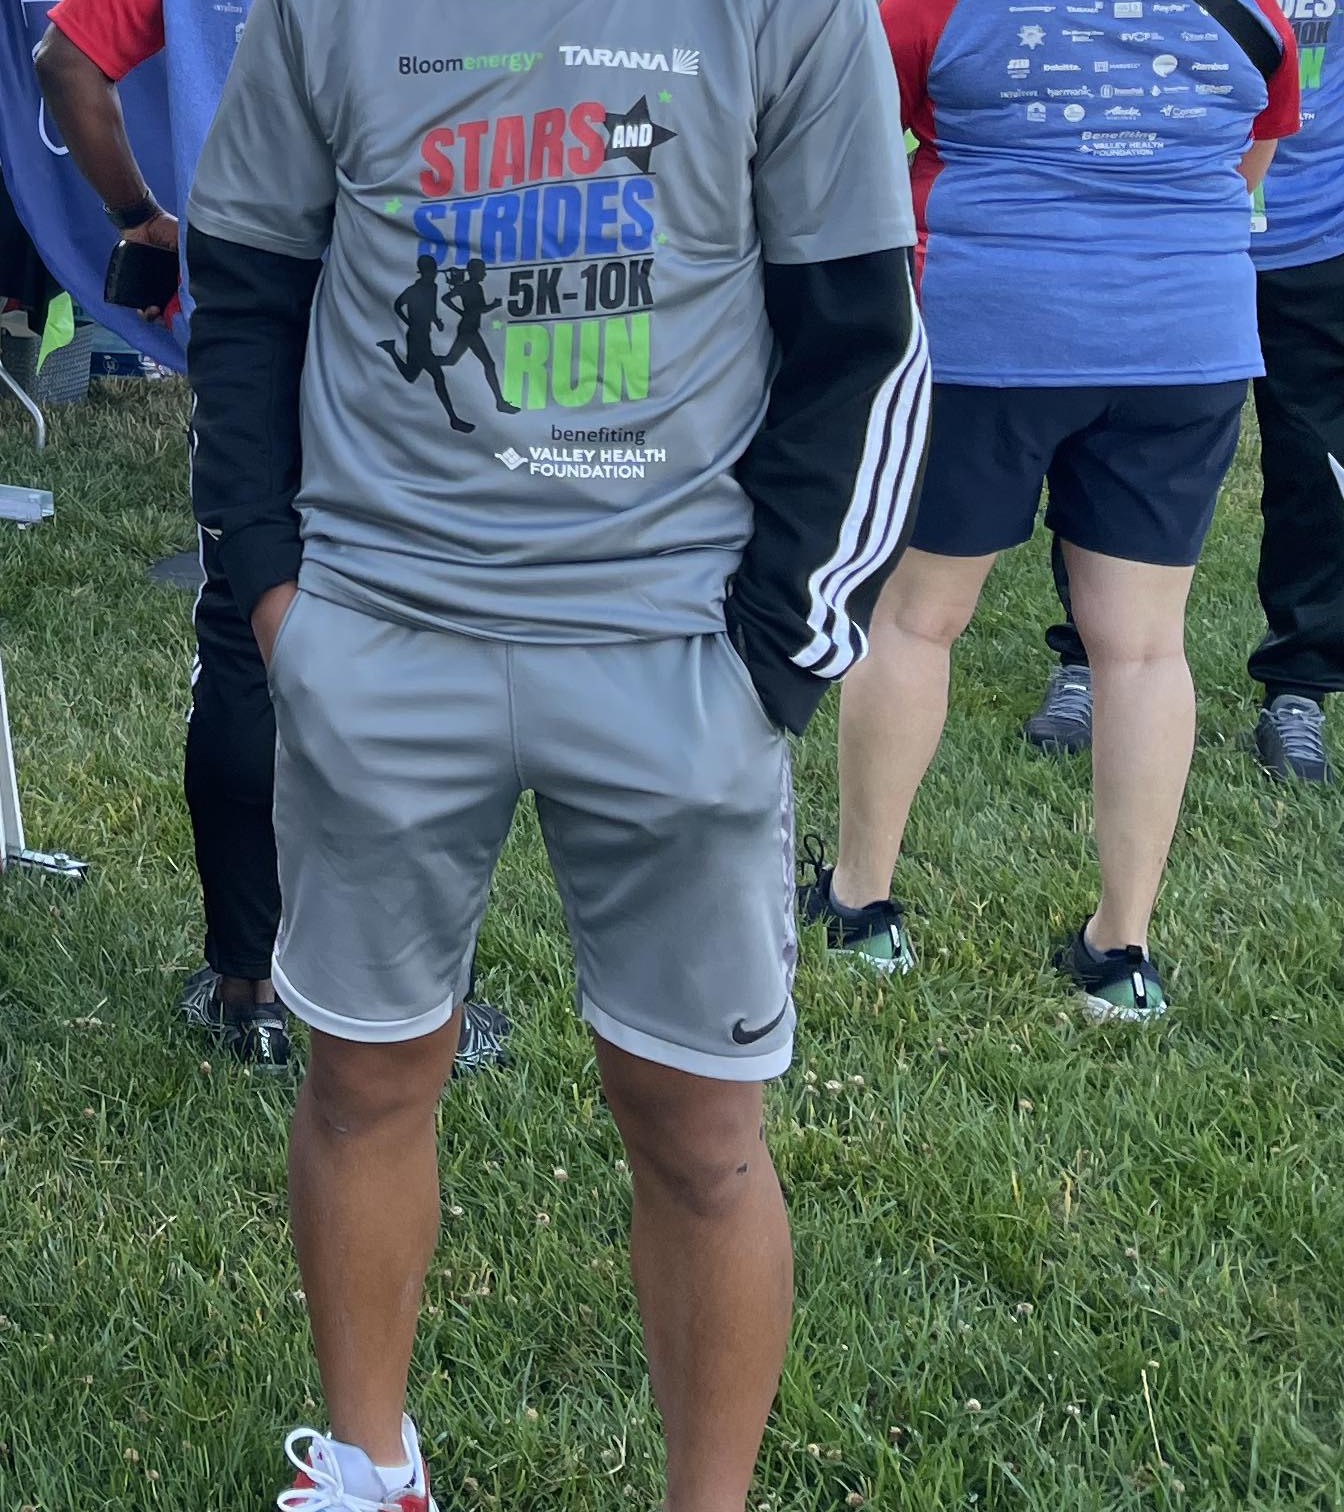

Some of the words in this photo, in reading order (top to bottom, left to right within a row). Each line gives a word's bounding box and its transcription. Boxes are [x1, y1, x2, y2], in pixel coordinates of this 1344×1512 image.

[559, 45, 669, 72] TARANA
[1081, 131, 1158, 141] Benefiting
[1129, 141, 1164, 149] HEALTH
[418, 101, 608, 197] STARS
[612, 122, 653, 149] AND
[413, 178, 655, 266] STRIDES
[507, 258, 654, 317] 5K-10K
[502, 312, 651, 411] RUN
[551, 424, 646, 446] benefiting
[529, 447, 596, 463] VALLEY
[600, 447, 666, 463] HEALTH
[529, 462, 646, 479] FOUNDATION
